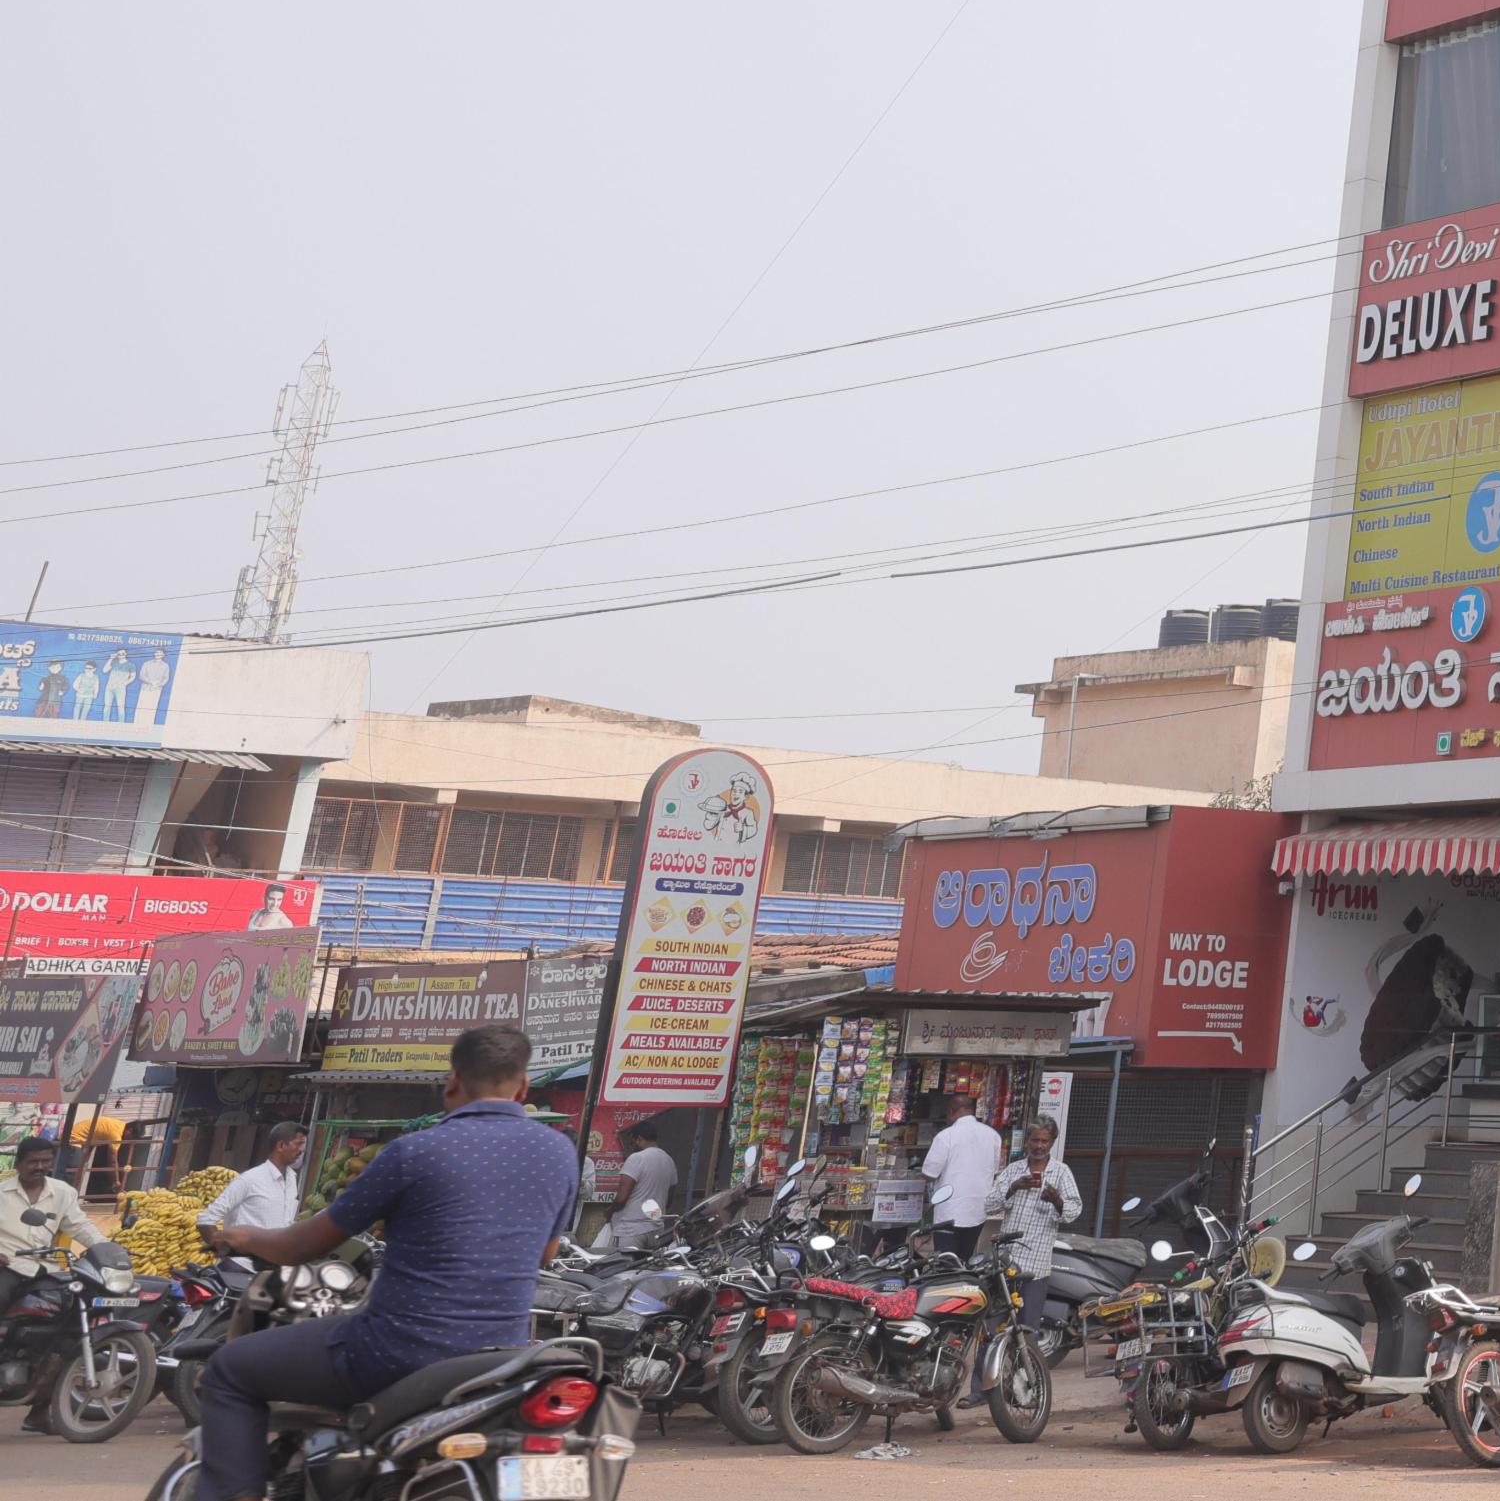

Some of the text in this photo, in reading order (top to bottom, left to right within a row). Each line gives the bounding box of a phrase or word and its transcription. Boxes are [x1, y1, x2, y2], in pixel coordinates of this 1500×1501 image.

[1368, 223, 1500, 283] Shri Devi
[1356, 278, 1496, 364] DELUXE
[1368, 388, 1460, 423] Udupi Hotel
[1359, 479, 1435, 503] South Indian
[1355, 510, 1431, 533] North Indian
[1352, 546, 1398, 564] Chinese
[1349, 577, 1382, 595] Multi
[1384, 573, 1430, 590] Cuisine
[711, 852, 757, 878] ಸಾಗರ
[1310, 868, 1378, 917] Arun
[12, 891, 109, 914] DOLLAR
[144, 899, 209, 915] BIGBOSS
[1329, 911, 1378, 922] ICECREAMS
[15, 937, 126, 948] BRIEF BOXER VEST
[654, 940, 729, 955] SOUTH INDIAN
[1169, 932, 1226, 953] WAY TO
[1047, 932, 1135, 983] ಬೇಕರಿ
[27, 959, 149, 974] ADHIKA GARME
[651, 959, 727, 974] NORTH INDIAN
[1162, 958, 1250, 989] LODGE
[430, 980, 455, 990] Assam
[458, 980, 471, 990] Tea
[639, 978, 733, 993] CHINESE & CHATS
[352, 977, 520, 1022] DANESHWARI TEA
[527, 991, 602, 1011] DANESHWAR
[640, 998, 725, 1013] JUICE, DESERTS
[650, 1017, 709, 1031] ICE-CREAM
[541, 1044, 573, 1058] Patil
[629, 1035, 723, 1050] MEALS AVAILABLE
[349, 1047, 403, 1064] Patil Traders
[624, 1055, 720, 1069] AC/ NON AC LODGE
[622, 1077, 716, 1087] OUTDOOR CATERING AVAILABLE
